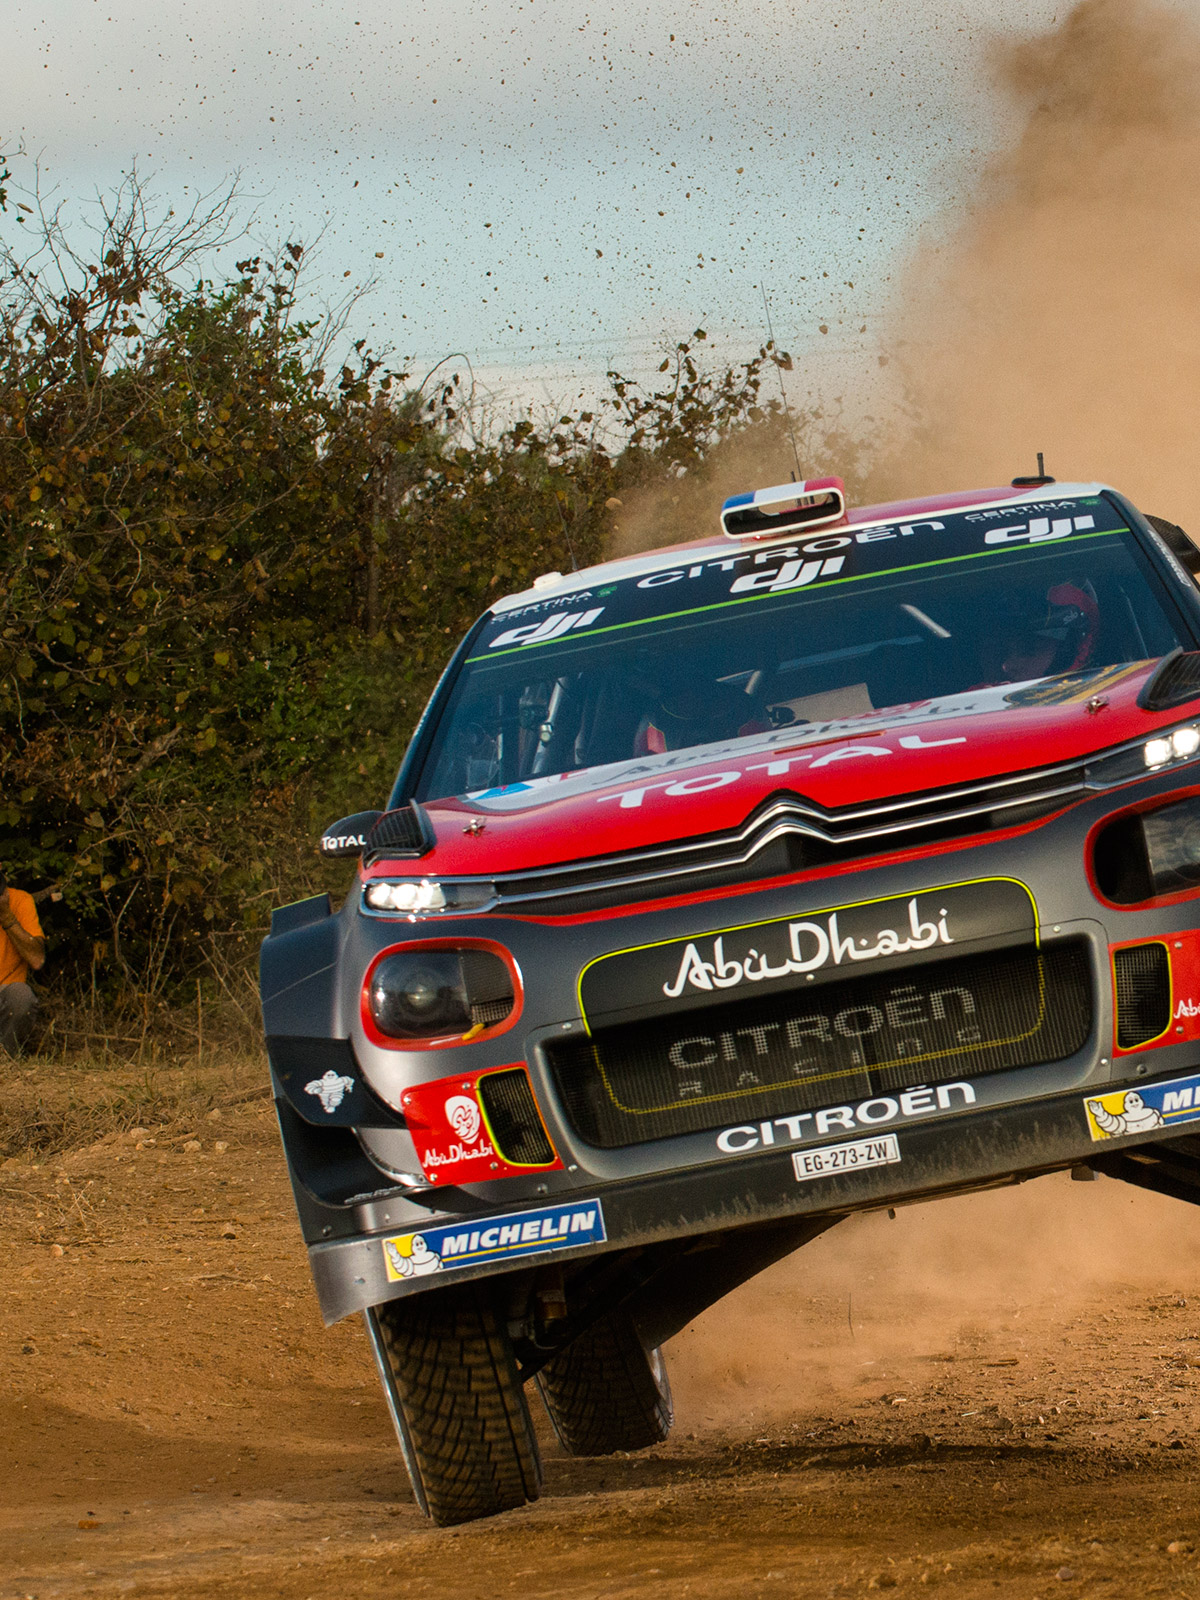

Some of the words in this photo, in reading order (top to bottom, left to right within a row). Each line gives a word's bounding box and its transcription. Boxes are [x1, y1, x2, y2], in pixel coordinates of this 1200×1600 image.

[964, 500, 1077, 521] CERTINA
[596, 735, 967, 808] TOTAL
[321, 834, 367, 850] TOTAL
[803, 1141, 889, 1173] EG-273-ZW
[441, 1210, 596, 1256] MICHELIN
